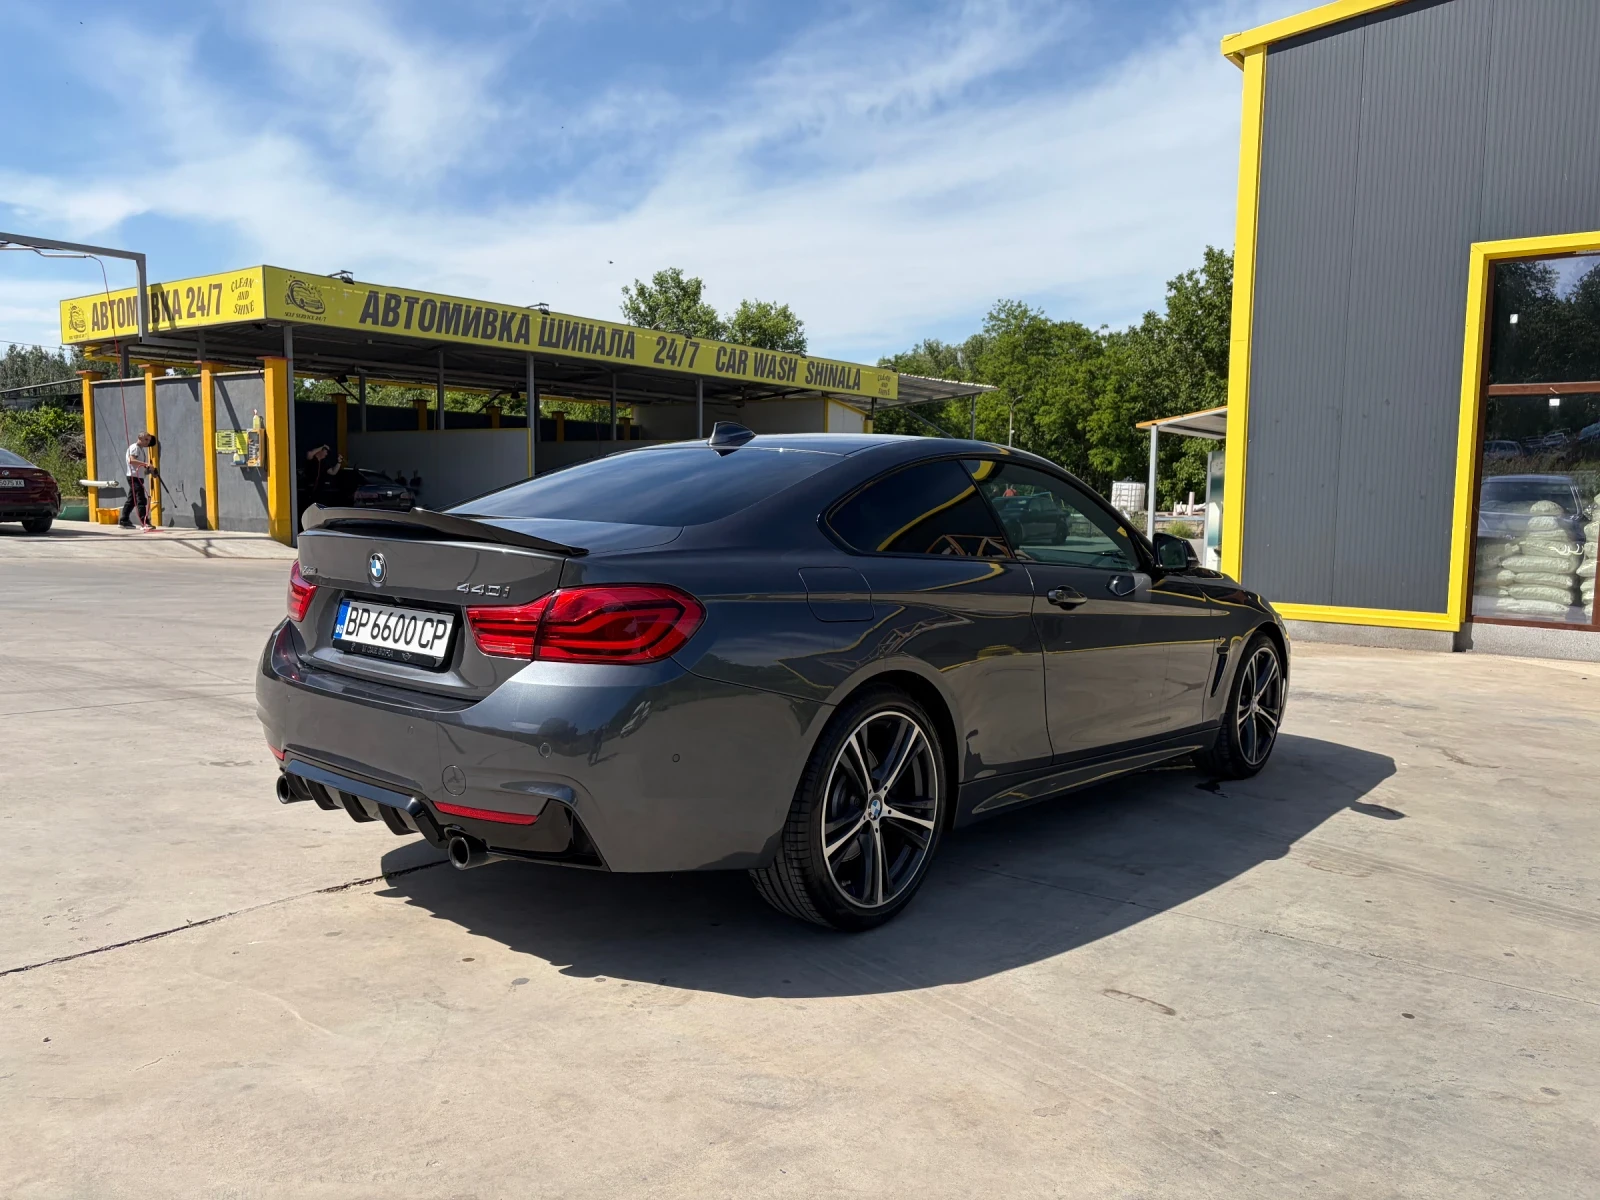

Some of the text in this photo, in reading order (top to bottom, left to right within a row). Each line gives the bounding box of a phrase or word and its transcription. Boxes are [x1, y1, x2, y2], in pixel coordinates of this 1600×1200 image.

[231, 277, 254, 292] CLEAN
[237, 290, 250, 301] AND
[92, 283, 223, 332] АВТОМВКА 24/7
[233, 300, 255, 315] SHINE
[359, 290, 700, 369] АВТОМИВКА ШИНАЛА 24/7
[715, 346, 861, 391] CAR WASH SHINALA
[456, 583, 511, 598] 440i
